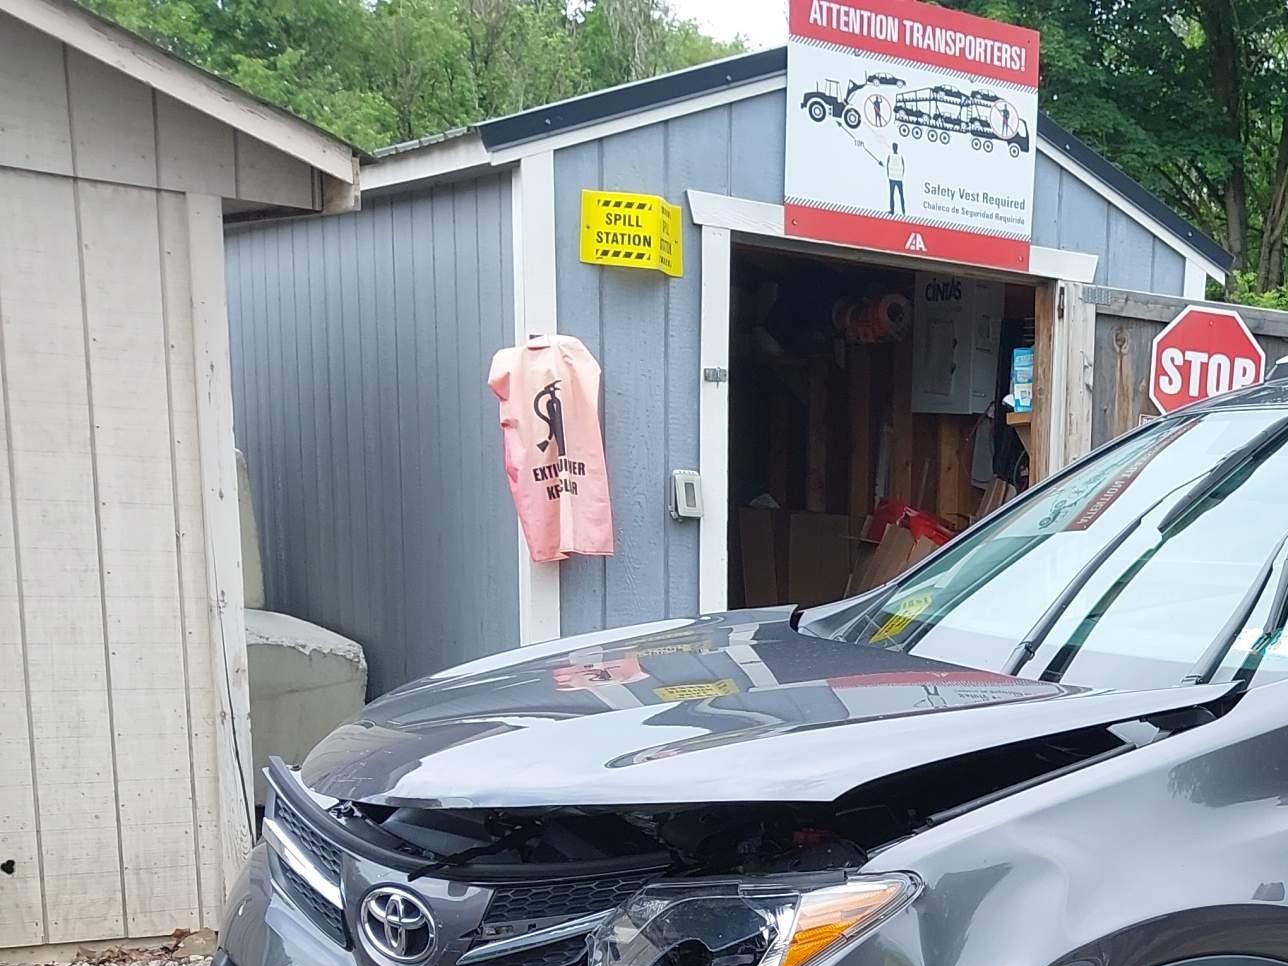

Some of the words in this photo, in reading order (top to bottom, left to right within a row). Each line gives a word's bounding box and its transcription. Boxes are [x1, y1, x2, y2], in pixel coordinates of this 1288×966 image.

[809, 0, 899, 43] ATTENTION
[903, 19, 1026, 72] TRANSPORTERS!
[923, 182, 956, 201] Safety
[958, 187, 980, 202] Vest
[982, 192, 1025, 210] Required
[605, 212, 643, 228] SPILL
[922, 201, 950, 213] Chaleco
[951, 205, 960, 214] de
[961, 207, 994, 220] Seguridad
[595, 230, 652, 248] STATION
[1159, 347, 1256, 397] STOP
